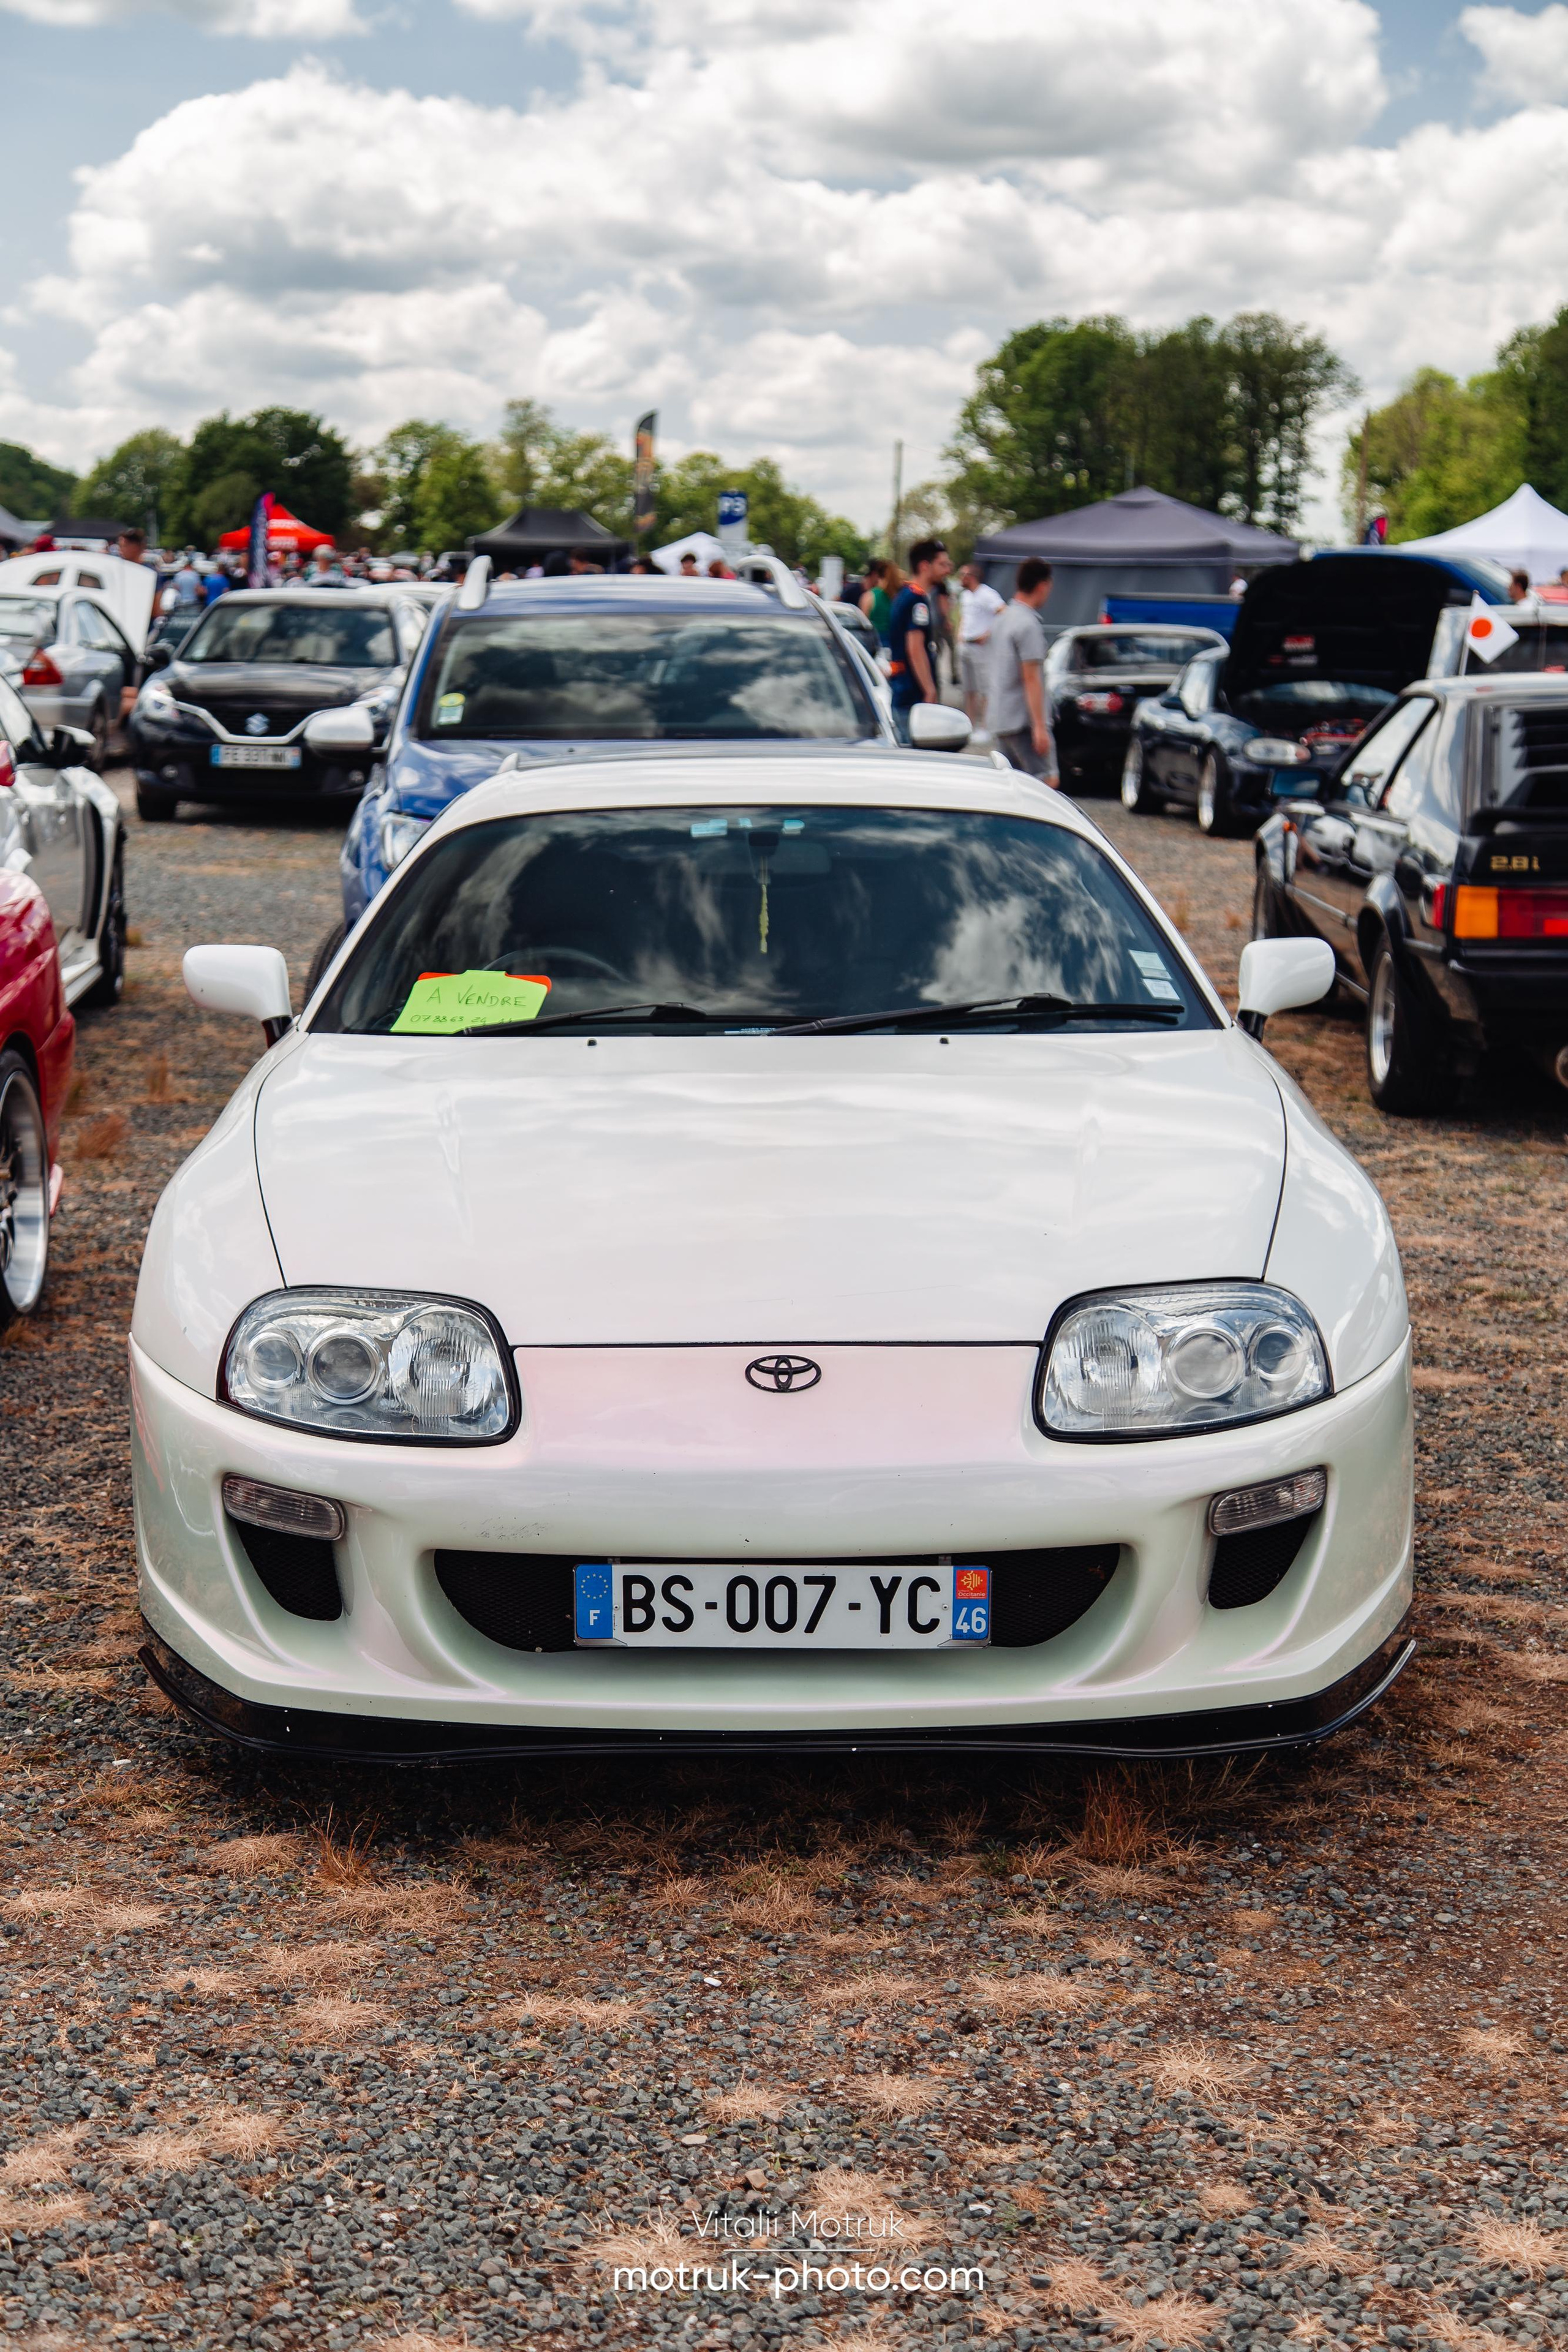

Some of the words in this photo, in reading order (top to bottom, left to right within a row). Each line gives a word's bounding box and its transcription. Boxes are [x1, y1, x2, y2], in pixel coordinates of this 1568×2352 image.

[426, 986, 440, 1004] A
[458, 984, 526, 1006] VENDRE
[622, 1575, 941, 1634] BS-007-YC
[590, 1610, 600, 1626] F
[956, 1607, 986, 1634] 46
